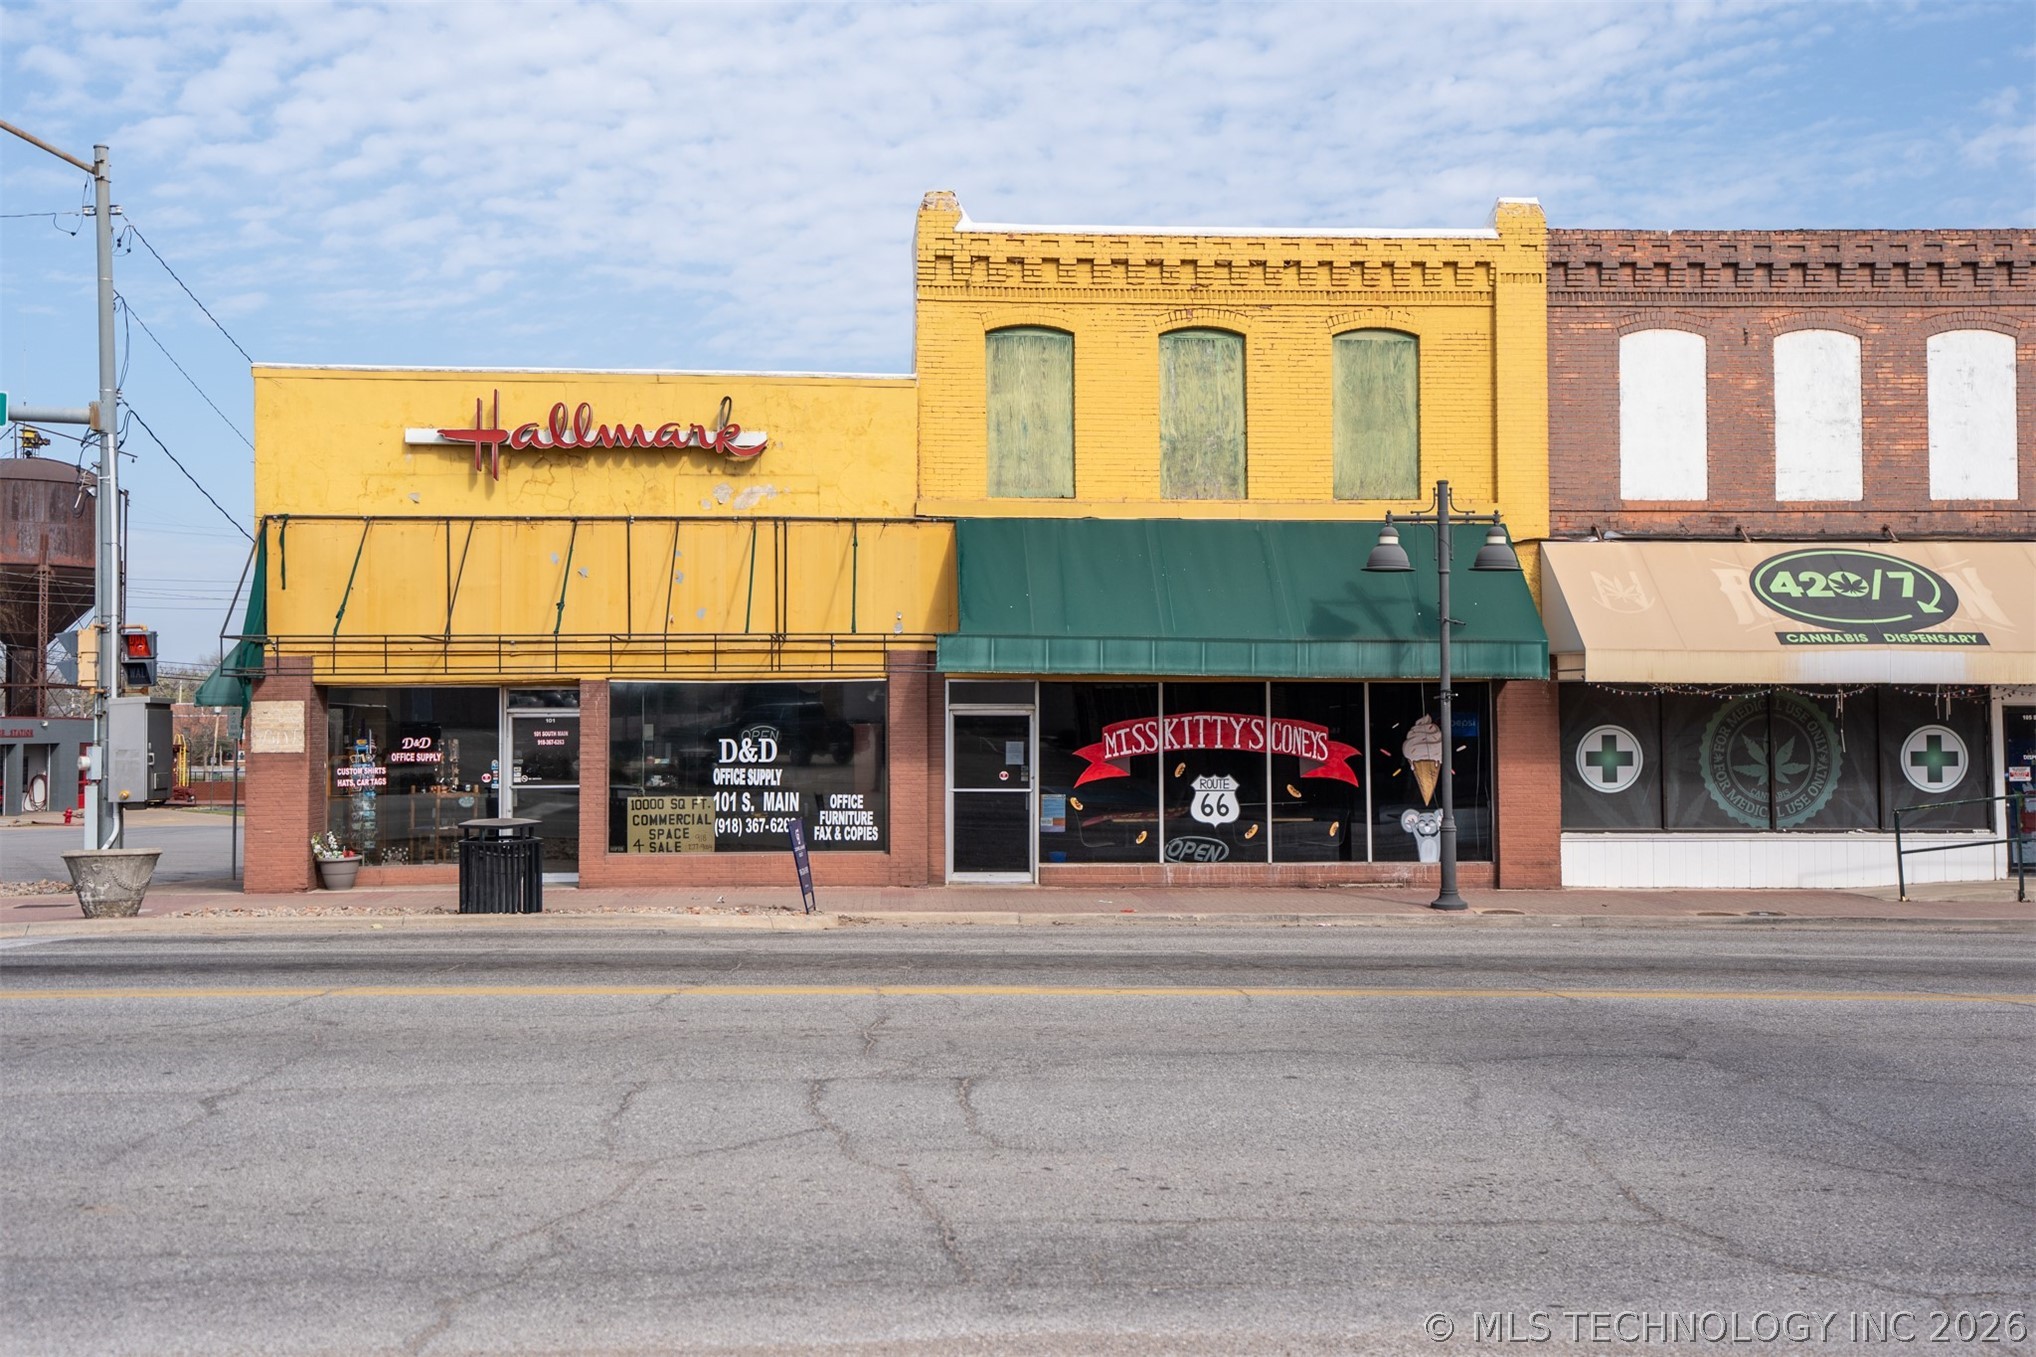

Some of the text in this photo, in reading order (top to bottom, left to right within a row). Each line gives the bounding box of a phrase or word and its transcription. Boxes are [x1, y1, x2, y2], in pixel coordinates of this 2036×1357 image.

[436, 389, 768, 481] Hallmark
[1786, 633, 1979, 644] CANNABIS DISPENSARY
[1713, 700, 1829, 755] FOR MEDICL USE ONLY
[402, 737, 432, 749] D&D
[1104, 715, 1329, 761] MISS KITTY'S CONEYS
[391, 752, 442, 762] OFFICE SUPPLY
[719, 738, 778, 763] D&D
[337, 767, 387, 775] CUSTOM SHIRTS
[713, 768, 783, 786] OFFICE SUPPLY
[337, 779, 356, 787] HATS,
[370, 778, 387, 786] TAGS
[1200, 778, 1230, 789] ROUTE
[1713, 762, 1829, 817] FOR MEDICL USE ONLY
[631, 798, 711, 811] 10000 SQ FT.
[713, 792, 800, 812] 101 S. MAIN
[830, 794, 864, 809] OFFICE
[1201, 793, 1230, 817] 66
[632, 813, 712, 826] COMMERCIAL
[820, 810, 874, 825] FURNITURE
[648, 827, 690, 840] SPACE
[714, 817, 797, 837] (918) 367-626
[814, 826, 879, 841] FAX & COPIES
[633, 838, 644, 853] 4
[649, 841, 682, 853] SALE
[1167, 840, 1222, 862] OPEN
